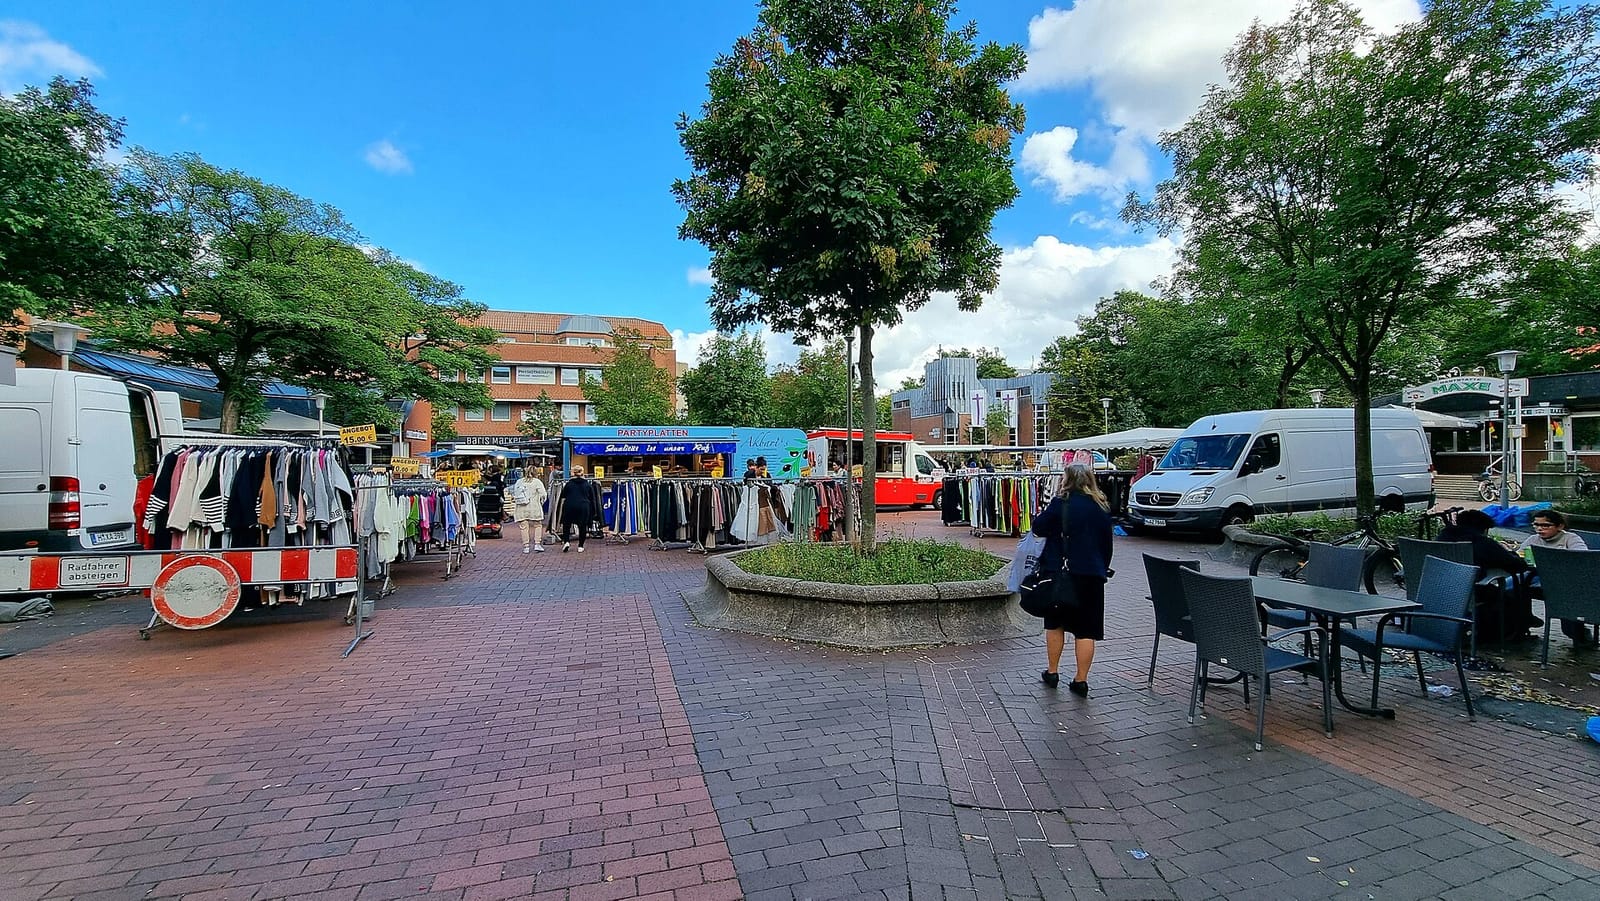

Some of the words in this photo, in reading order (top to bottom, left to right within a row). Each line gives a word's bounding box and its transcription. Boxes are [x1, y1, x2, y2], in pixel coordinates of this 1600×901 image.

[1431, 382, 1492, 394] MAXE
[342, 425, 374, 435] ANGEBOT
[617, 429, 689, 437] PARTYPLATTEN
[391, 457, 419, 466] ANGEBOT
[67, 562, 120, 572] Radfahrer
[68, 572, 119, 581] absteigen
